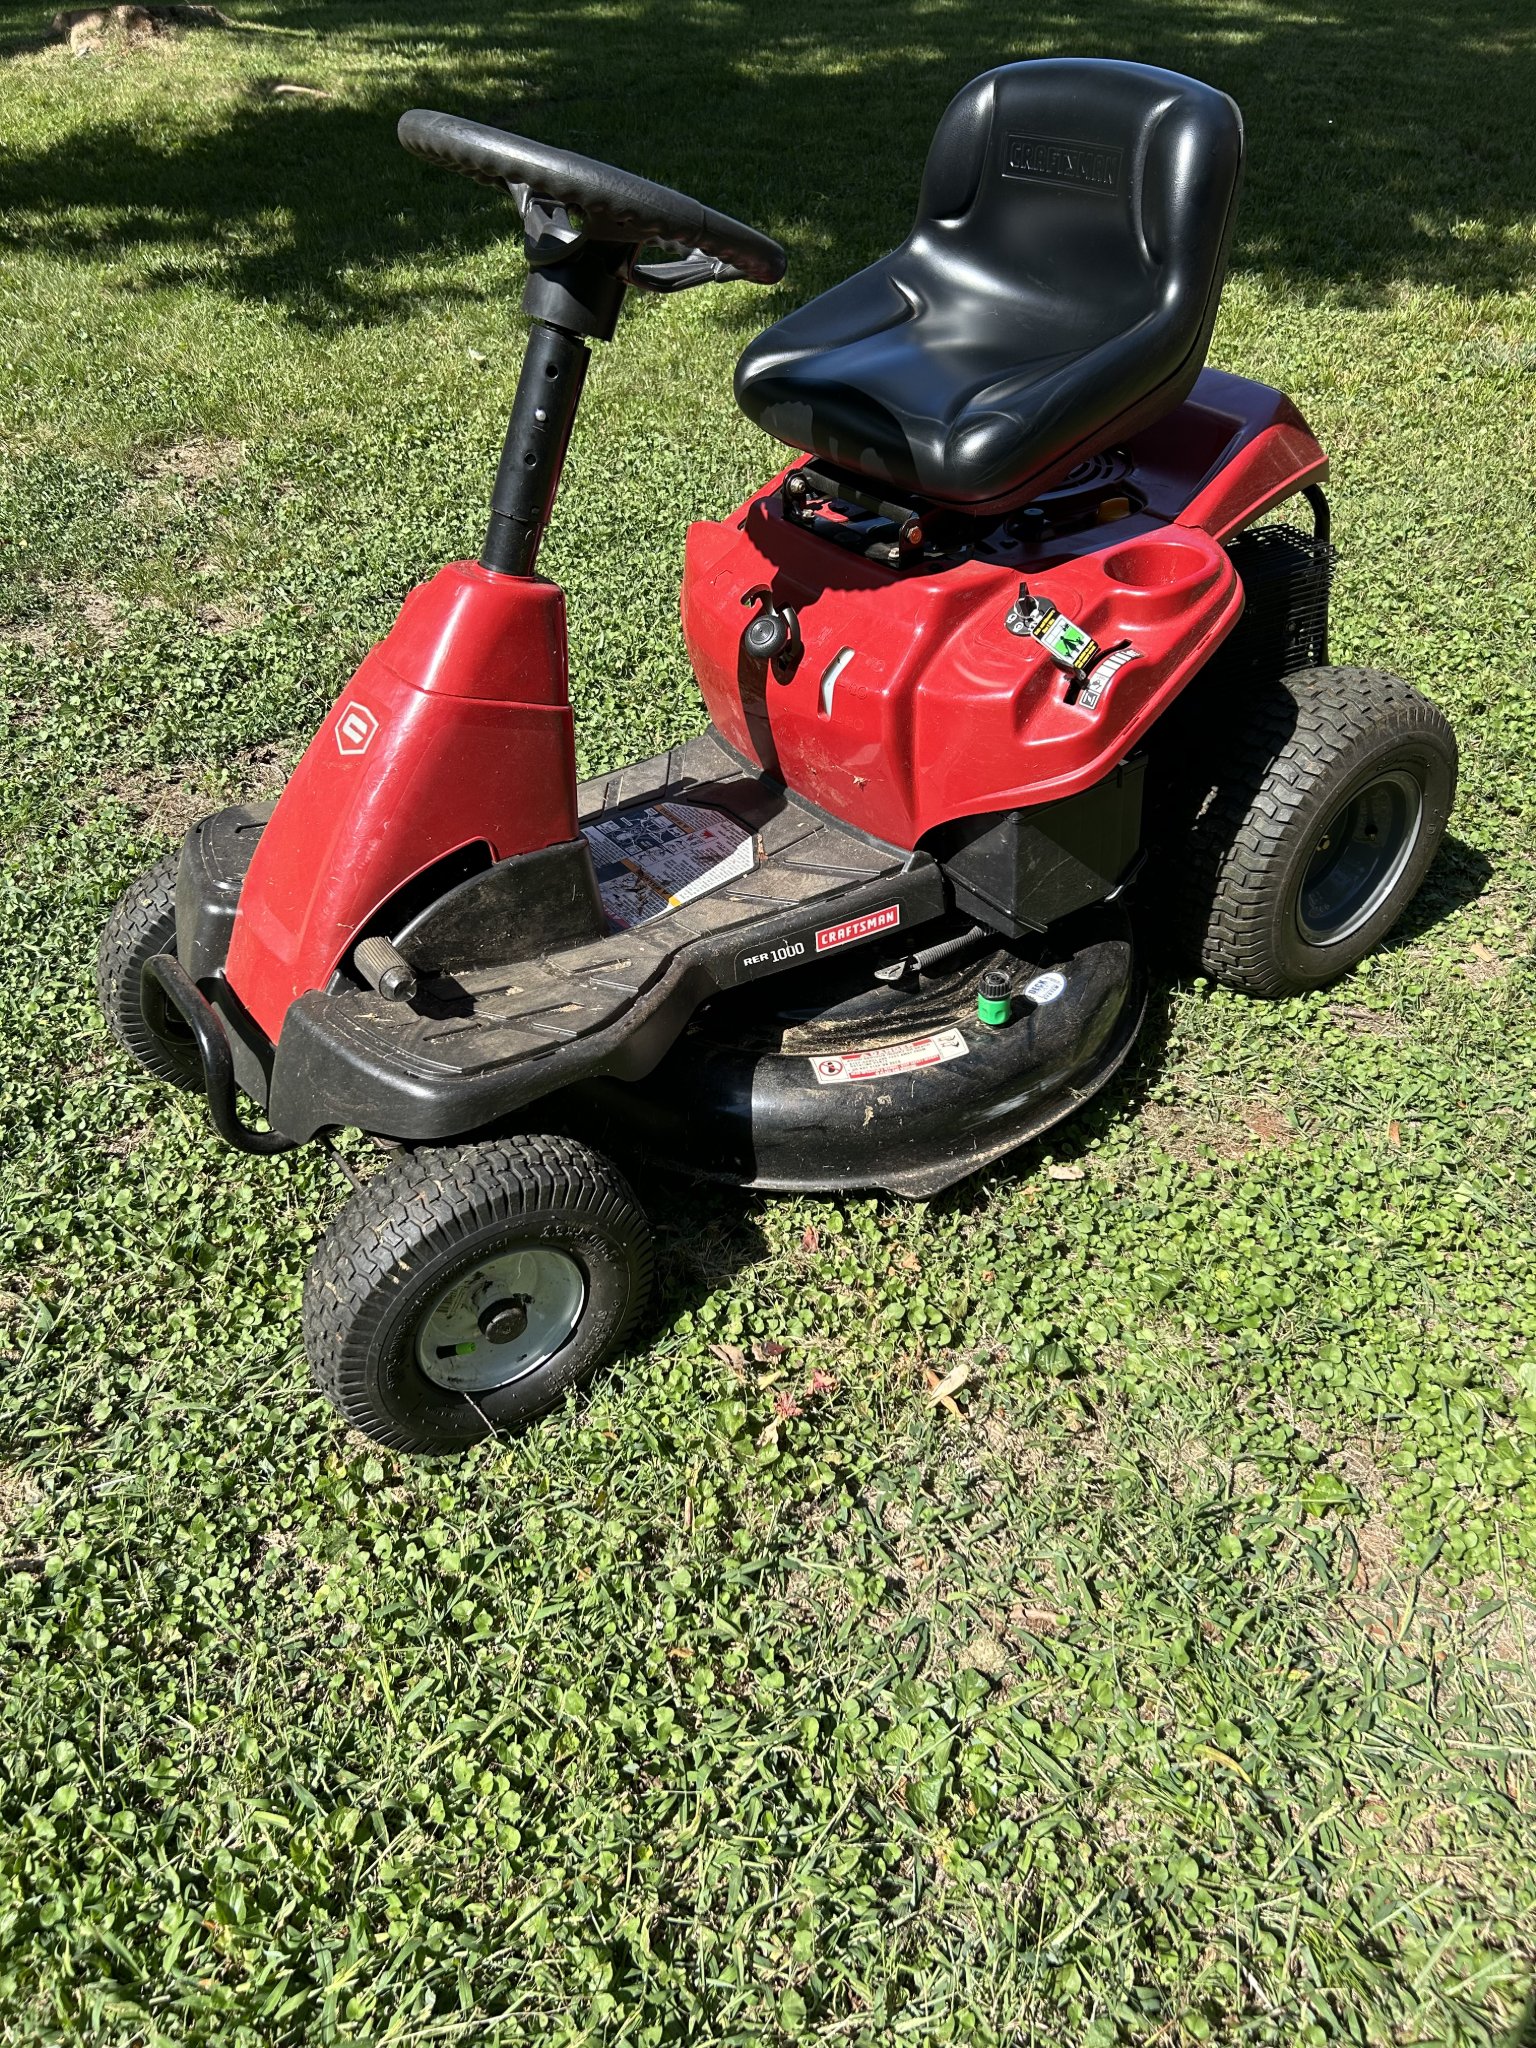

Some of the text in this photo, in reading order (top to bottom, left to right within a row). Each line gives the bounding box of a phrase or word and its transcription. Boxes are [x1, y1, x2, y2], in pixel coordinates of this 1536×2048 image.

[821, 913, 895, 945] CRAFTSMAN
[743, 942, 805, 966] RER 1000
